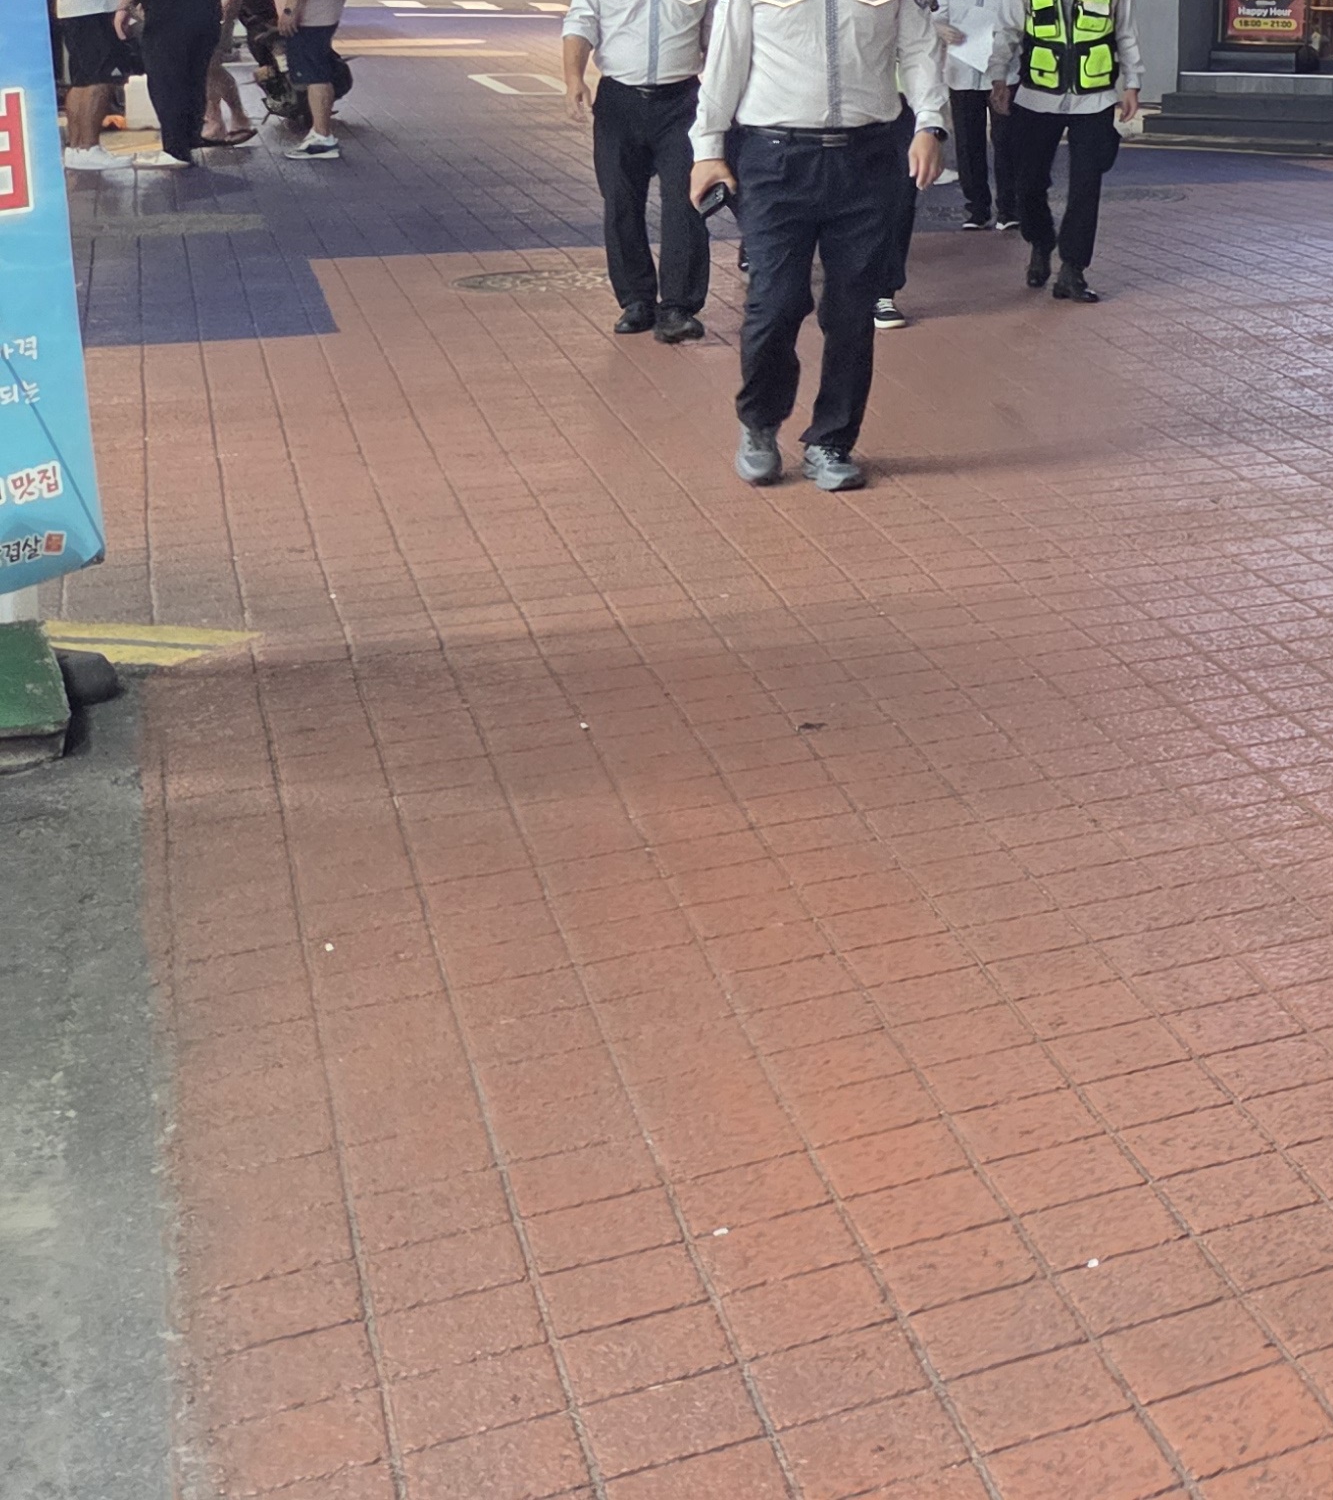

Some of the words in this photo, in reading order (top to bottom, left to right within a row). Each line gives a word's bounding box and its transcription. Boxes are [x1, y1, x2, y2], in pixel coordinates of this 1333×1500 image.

[1238, 6, 1268, 17] Happy
[1269, 7, 1292, 17] Hour
[11, 464, 60, 504] 맛집
[0, 535, 43, 564] 겹살
